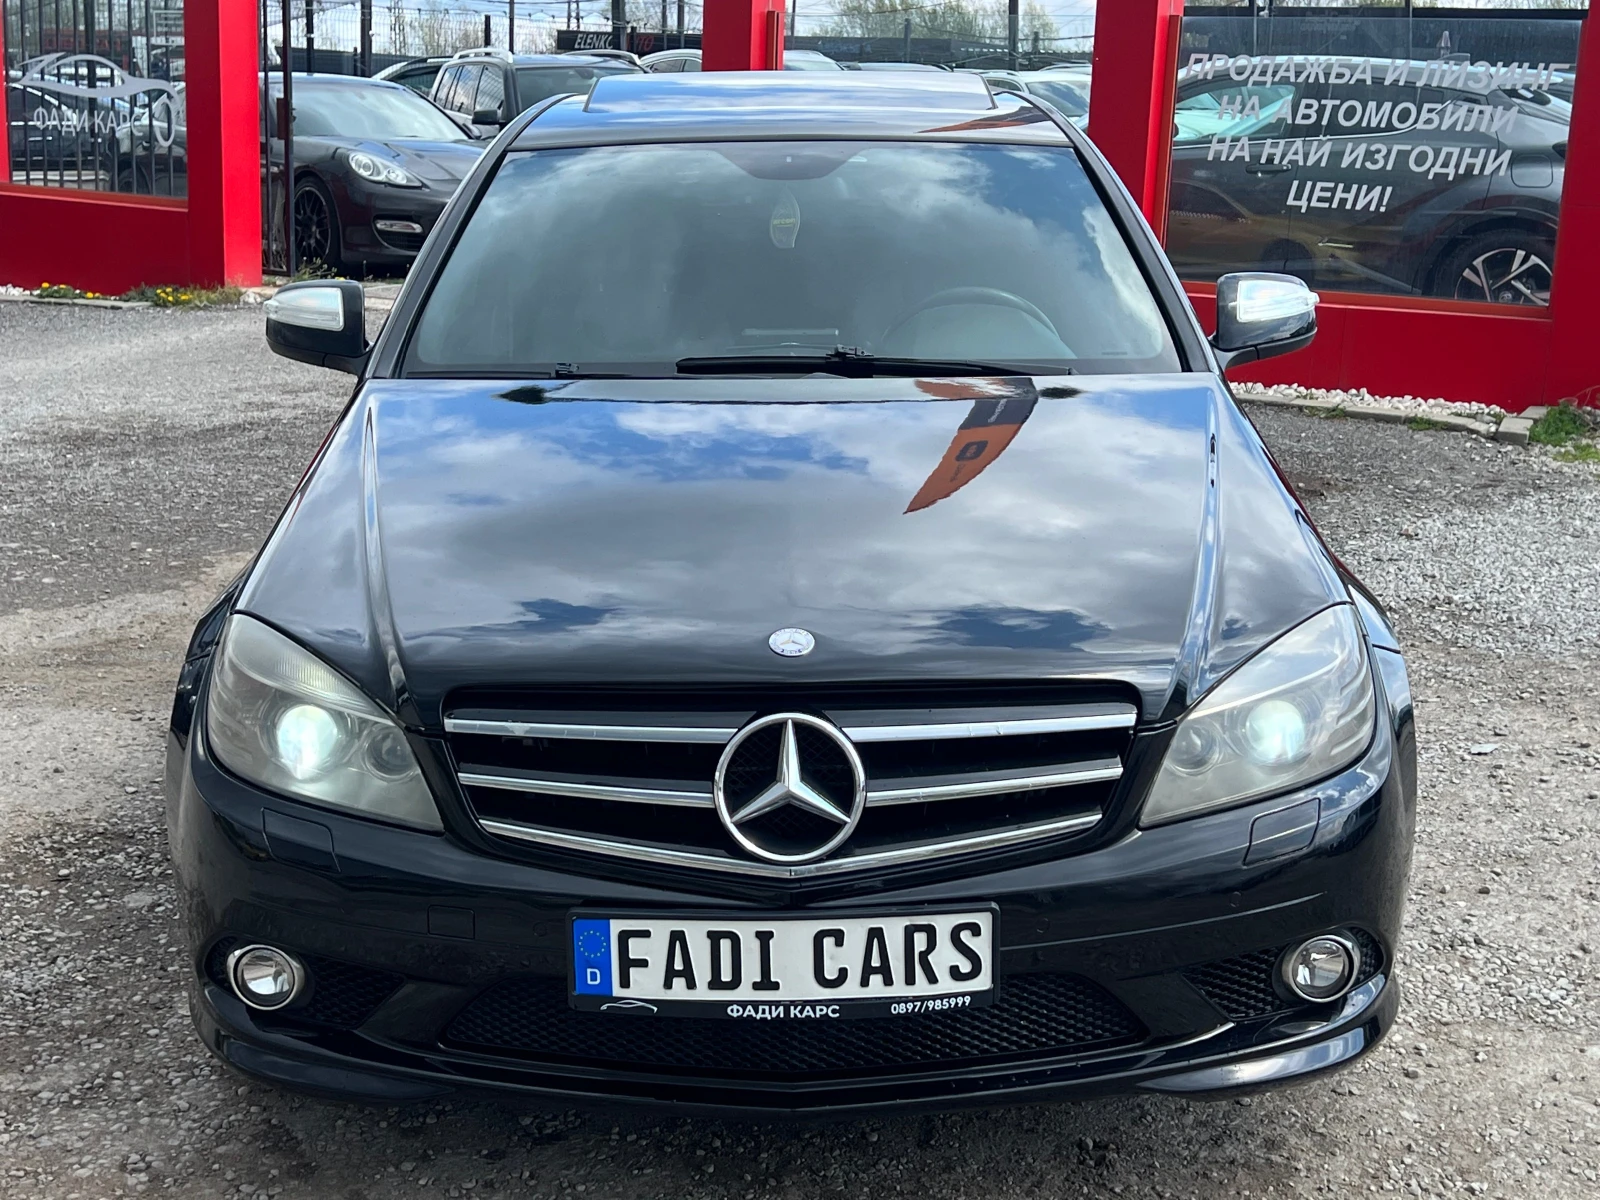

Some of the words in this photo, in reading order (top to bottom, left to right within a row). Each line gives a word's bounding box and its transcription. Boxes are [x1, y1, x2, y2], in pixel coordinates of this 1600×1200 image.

[1185, 53, 1373, 87] ПРОДАЖБА
[1384, 59, 1410, 86] И
[1415, 60, 1570, 91] ЛИЗИНГ
[34, 106, 89, 137] ФАДИ
[94, 110, 144, 136] КАРС
[1217, 94, 1262, 120] НА
[1271, 98, 1519, 133] АВТОМОБИЛИ
[1207, 135, 1251, 162] НА
[1260, 135, 1332, 167] НАЙ
[1341, 142, 1512, 180] ИЗГОДНИ
[1286, 180, 1393, 213] ЦЕНИ!
[617, 929, 780, 990] FADI
[812, 922, 982, 988] CARS
[586, 968, 601, 986] D
[726, 1004, 784, 1020] ФАДИ
[790, 1005, 840, 1018] КАРС
[890, 996, 972, 1015] 0897/985999
